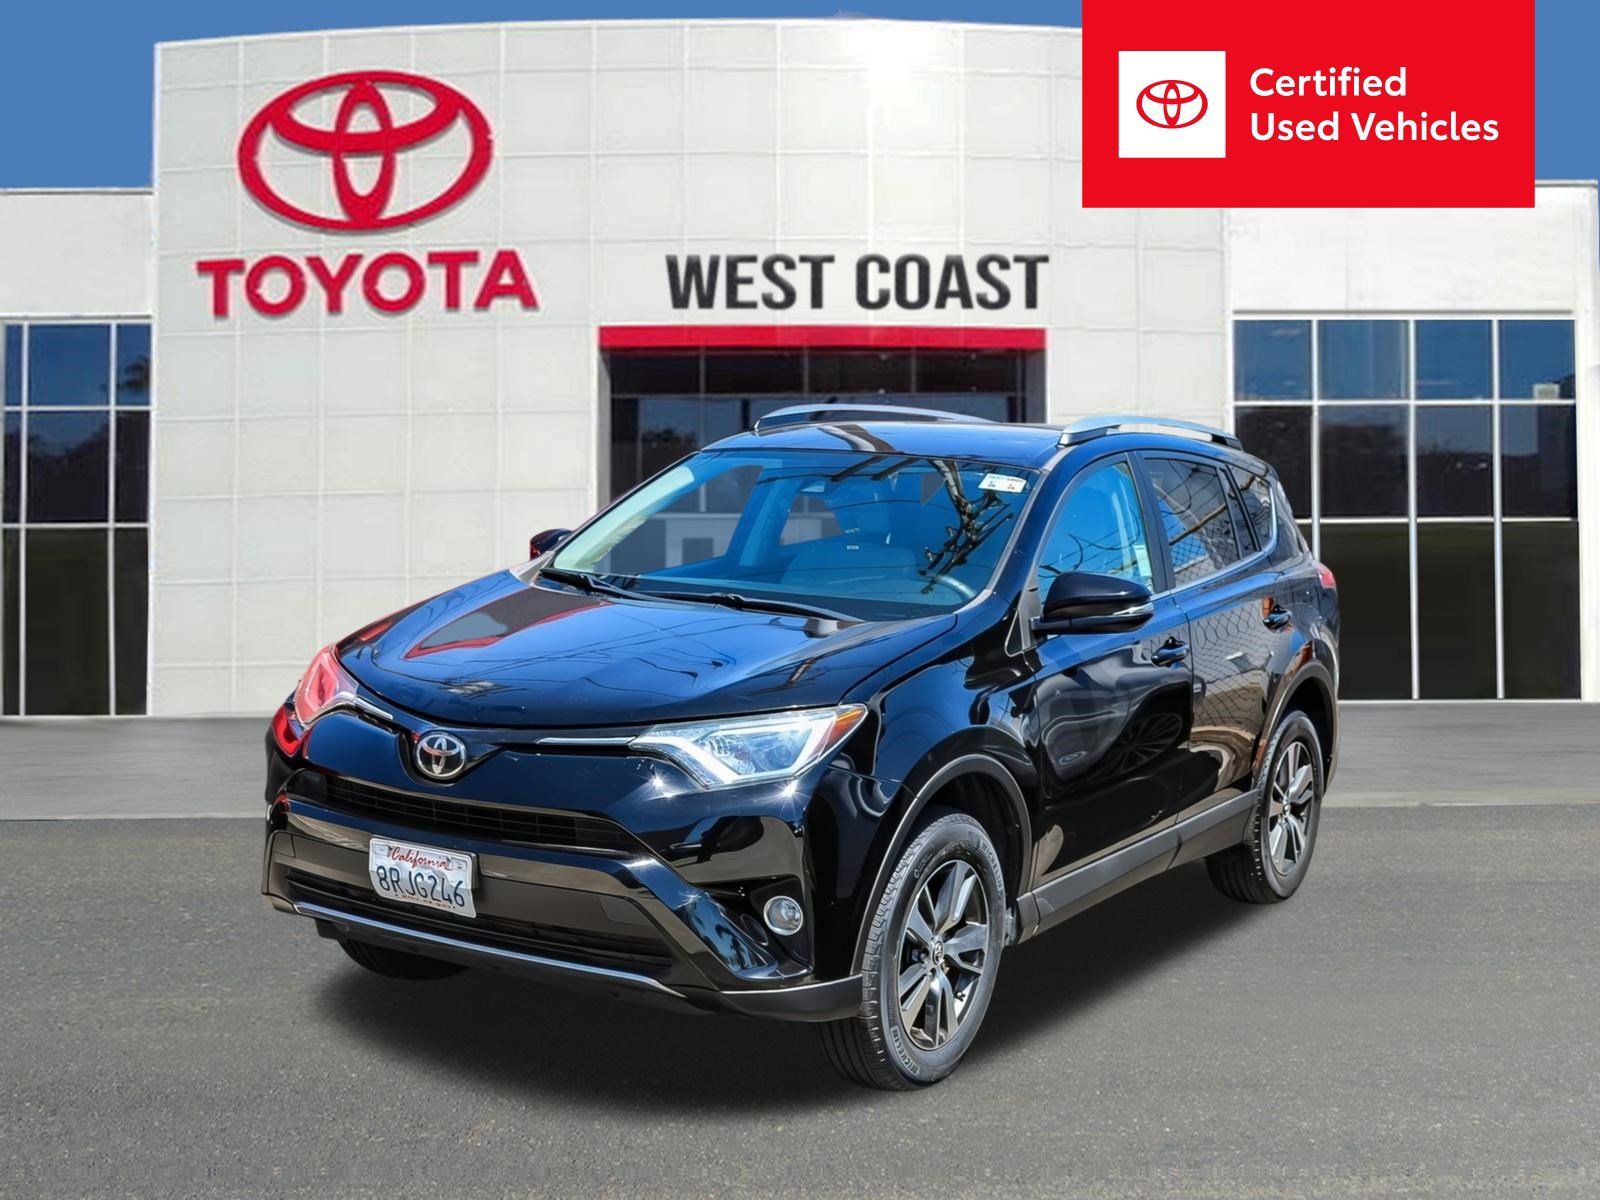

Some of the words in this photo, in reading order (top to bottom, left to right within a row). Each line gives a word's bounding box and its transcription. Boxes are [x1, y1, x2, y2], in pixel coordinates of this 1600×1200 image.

[196, 249, 539, 317] TOYOTA
[666, 254, 835, 310] WEST
[856, 254, 1050, 311] COAST
[391, 846, 453, 870] California
[376, 864, 466, 908] 8RJG246
